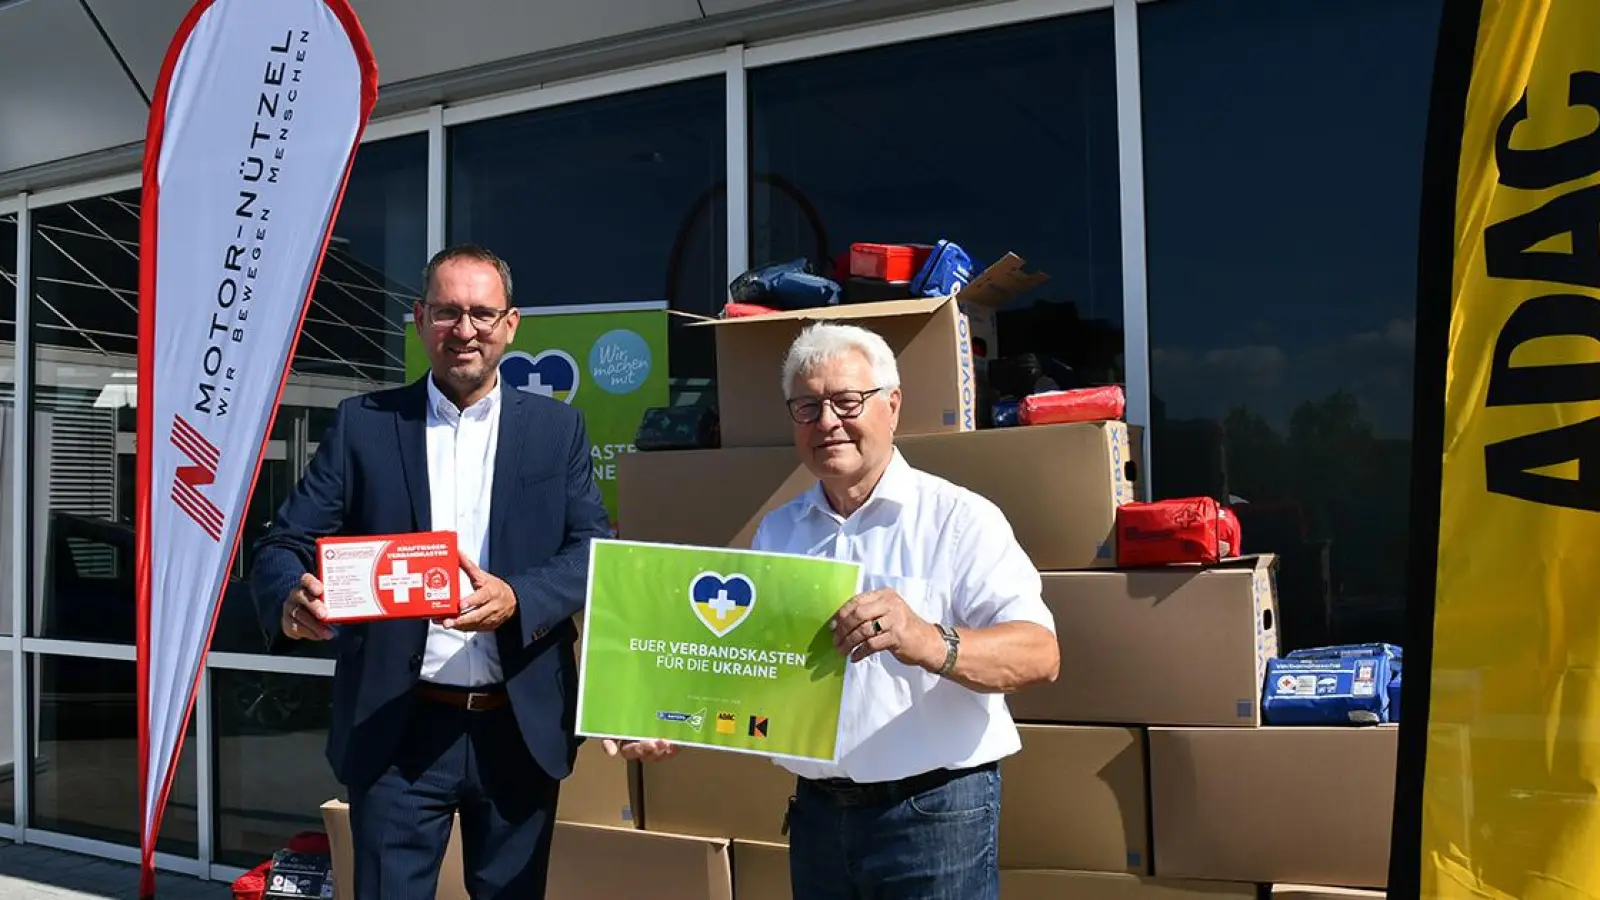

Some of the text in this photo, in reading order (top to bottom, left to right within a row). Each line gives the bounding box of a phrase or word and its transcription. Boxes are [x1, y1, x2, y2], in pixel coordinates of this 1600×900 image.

[194, 29, 293, 414] MOTOR-NÜTZEL
[216, 30, 310, 417] WIR BEWEGEN MENSCHEN
[1483, 69, 1600, 513] ADAC
[593, 357, 649, 377] machen
[599, 343, 628, 364] Wir
[610, 369, 636, 386] mit
[958, 317, 973, 430] MOVEBO
[629, 638, 807, 667] EUER VERBANDSKASTEN
[656, 654, 778, 679] FÜR DIE UKRAINE
